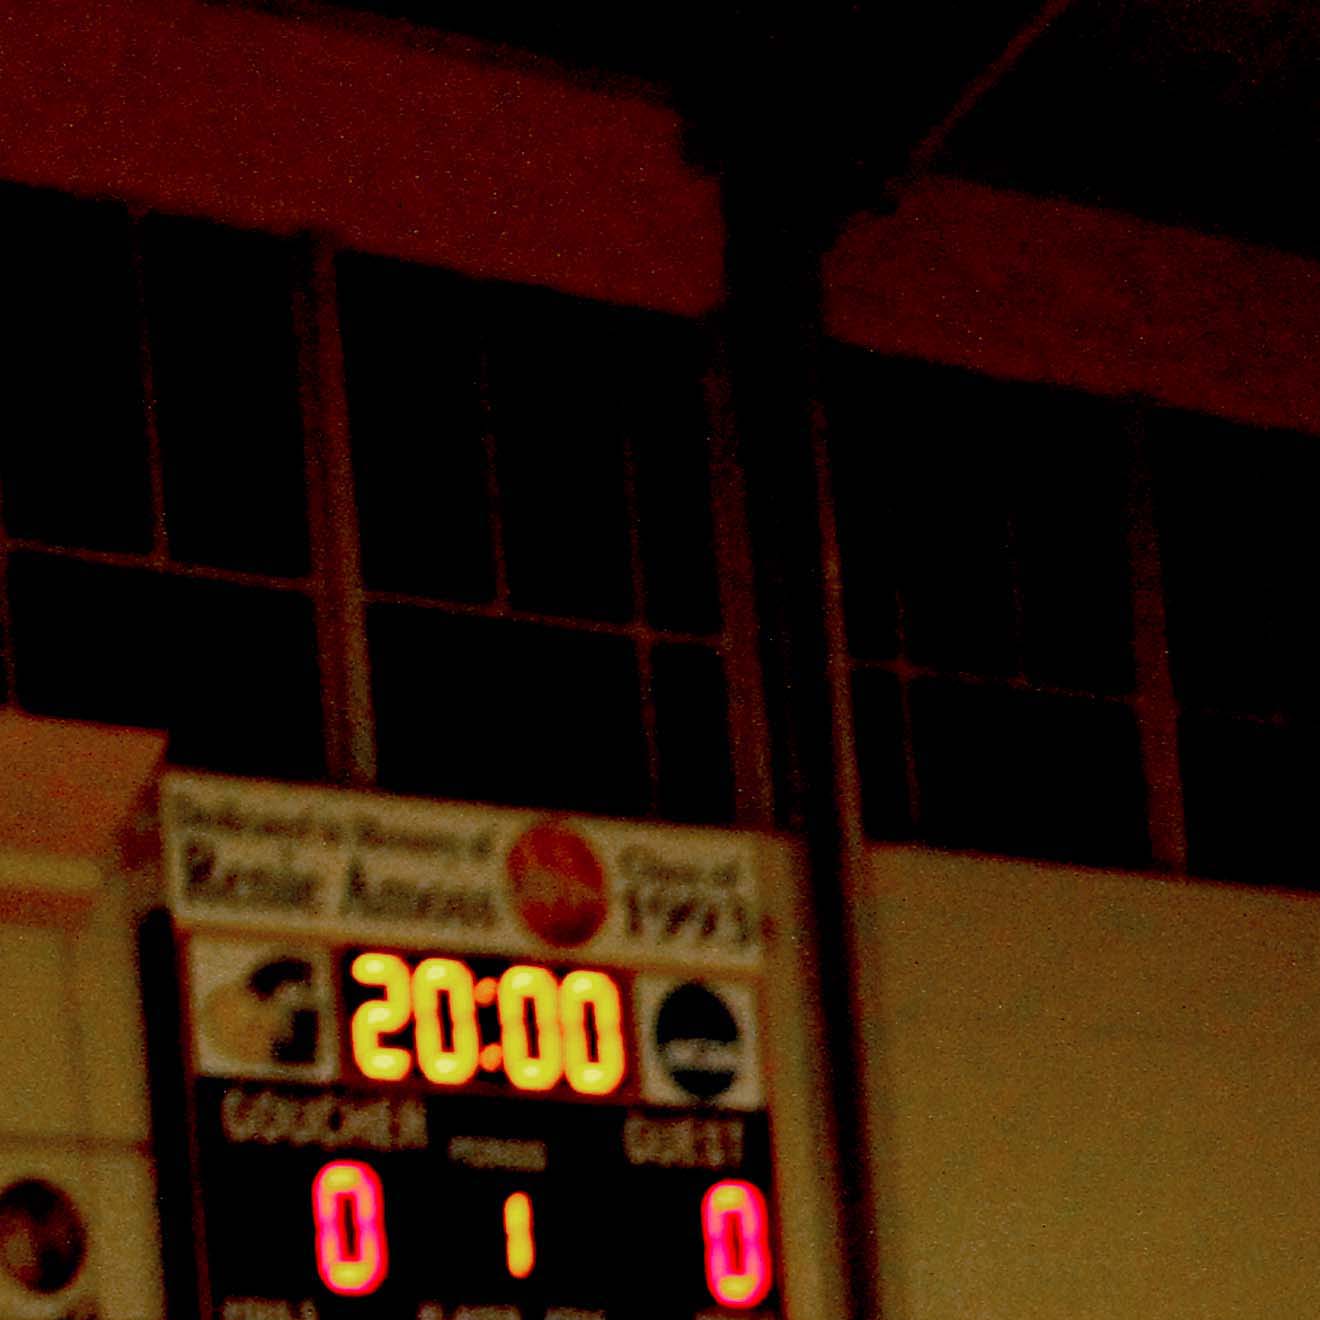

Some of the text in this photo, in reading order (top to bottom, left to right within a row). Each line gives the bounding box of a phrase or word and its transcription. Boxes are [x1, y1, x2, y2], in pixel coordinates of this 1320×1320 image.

[350, 951, 627, 1096] 20:00
[222, 1088, 428, 1150] GOUCHER
[623, 1111, 744, 1168] GUEST
[311, 1159, 388, 1296] 0
[504, 1191, 535, 1279] 1
[701, 1178, 773, 1309] 0
